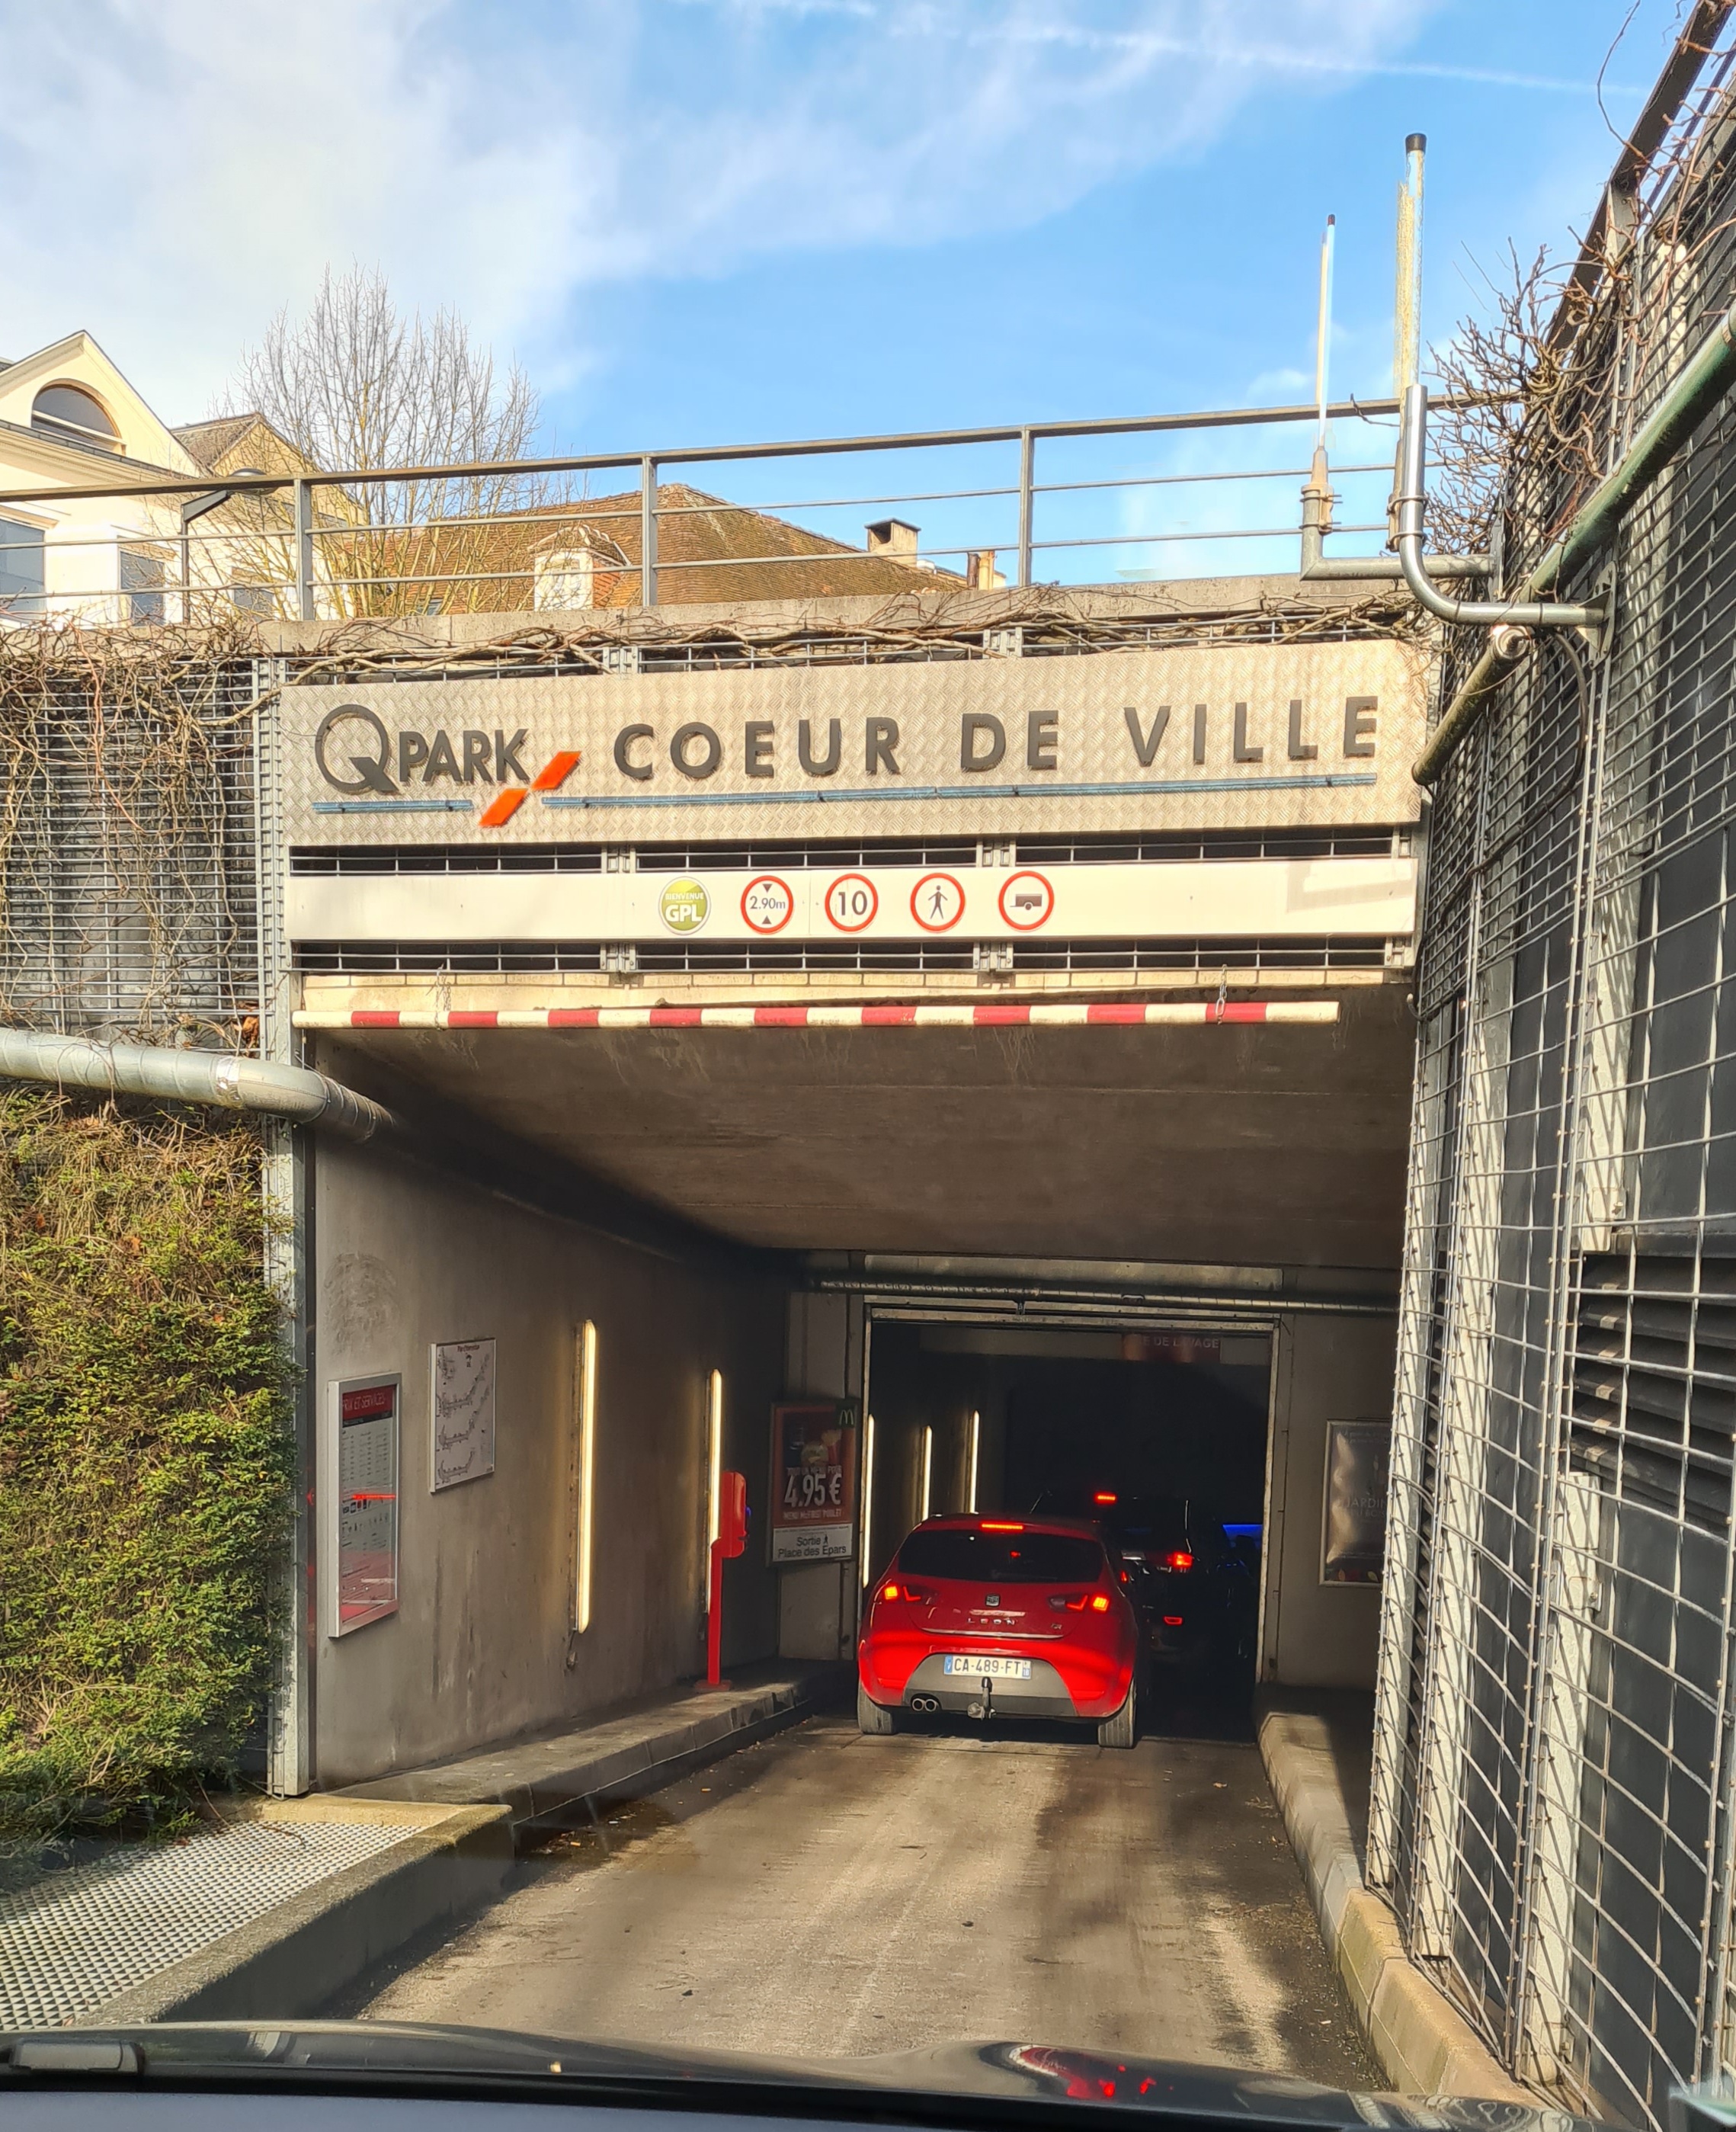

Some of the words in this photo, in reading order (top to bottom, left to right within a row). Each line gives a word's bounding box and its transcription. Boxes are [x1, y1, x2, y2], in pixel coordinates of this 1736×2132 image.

[614, 716, 901, 781] COEUR
[961, 710, 1059, 772] DE
[1124, 695, 1379, 767] VILLE
[665, 892, 704, 900] BIENVENUE
[750, 896, 786, 910] 2.90m
[839, 890, 868, 916] 10
[665, 904, 703, 922] GPL
[1173, 1337, 1219, 1348] LVAGE
[796, 1536, 821, 1547] Sortie
[778, 1547, 802, 1558] Place
[804, 1547, 820, 1557] des
[967, 1617, 1016, 1626] LEON
[954, 1658, 1021, 1675] CA-489-FT
